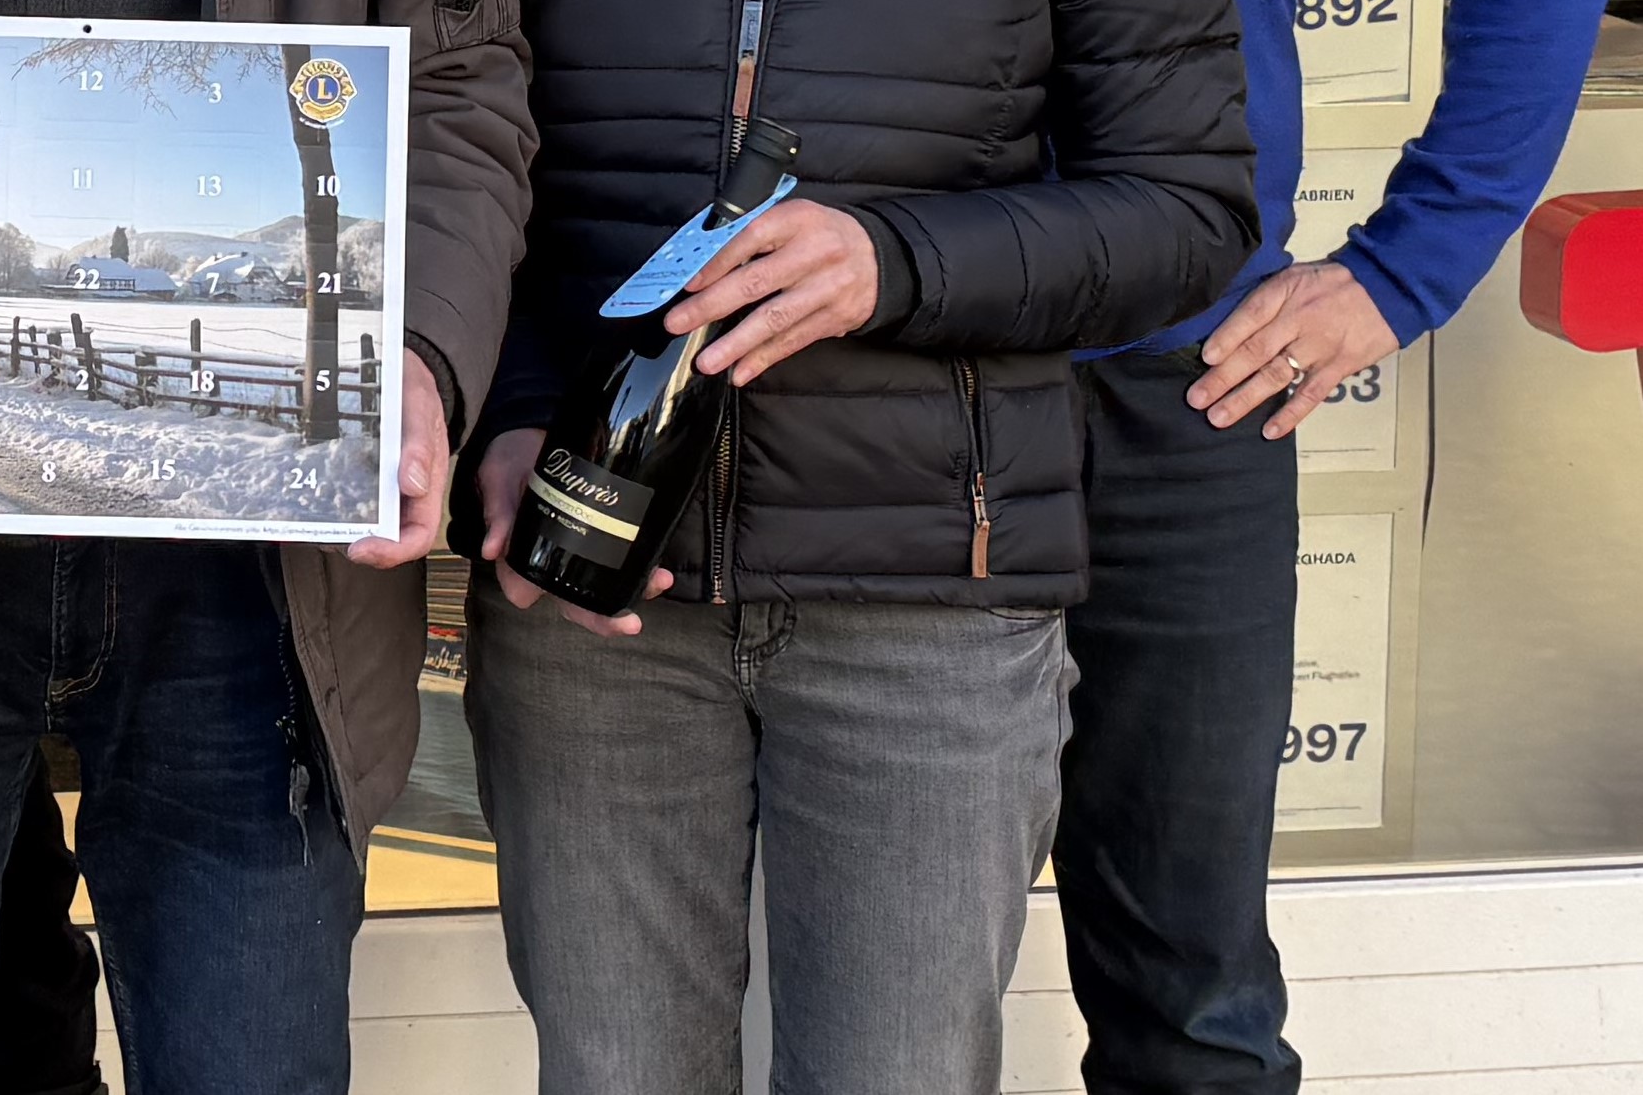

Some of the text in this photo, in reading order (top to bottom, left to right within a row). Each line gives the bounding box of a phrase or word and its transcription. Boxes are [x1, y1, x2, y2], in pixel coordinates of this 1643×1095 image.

[79, 70, 104, 92] 12
[317, 77, 334, 100] L
[207, 82, 223, 104] 3
[71, 168, 94, 191] 11
[196, 175, 223, 197] 13
[315, 174, 341, 197] 10
[73, 267, 101, 290] 22
[205, 271, 220, 294] 7
[317, 271, 343, 295] 21
[75, 369, 90, 392] 2
[189, 370, 215, 393] 18
[315, 369, 331, 392] 5
[41, 460, 57, 483] 8
[150, 458, 176, 482] 15
[289, 467, 318, 490] 24
